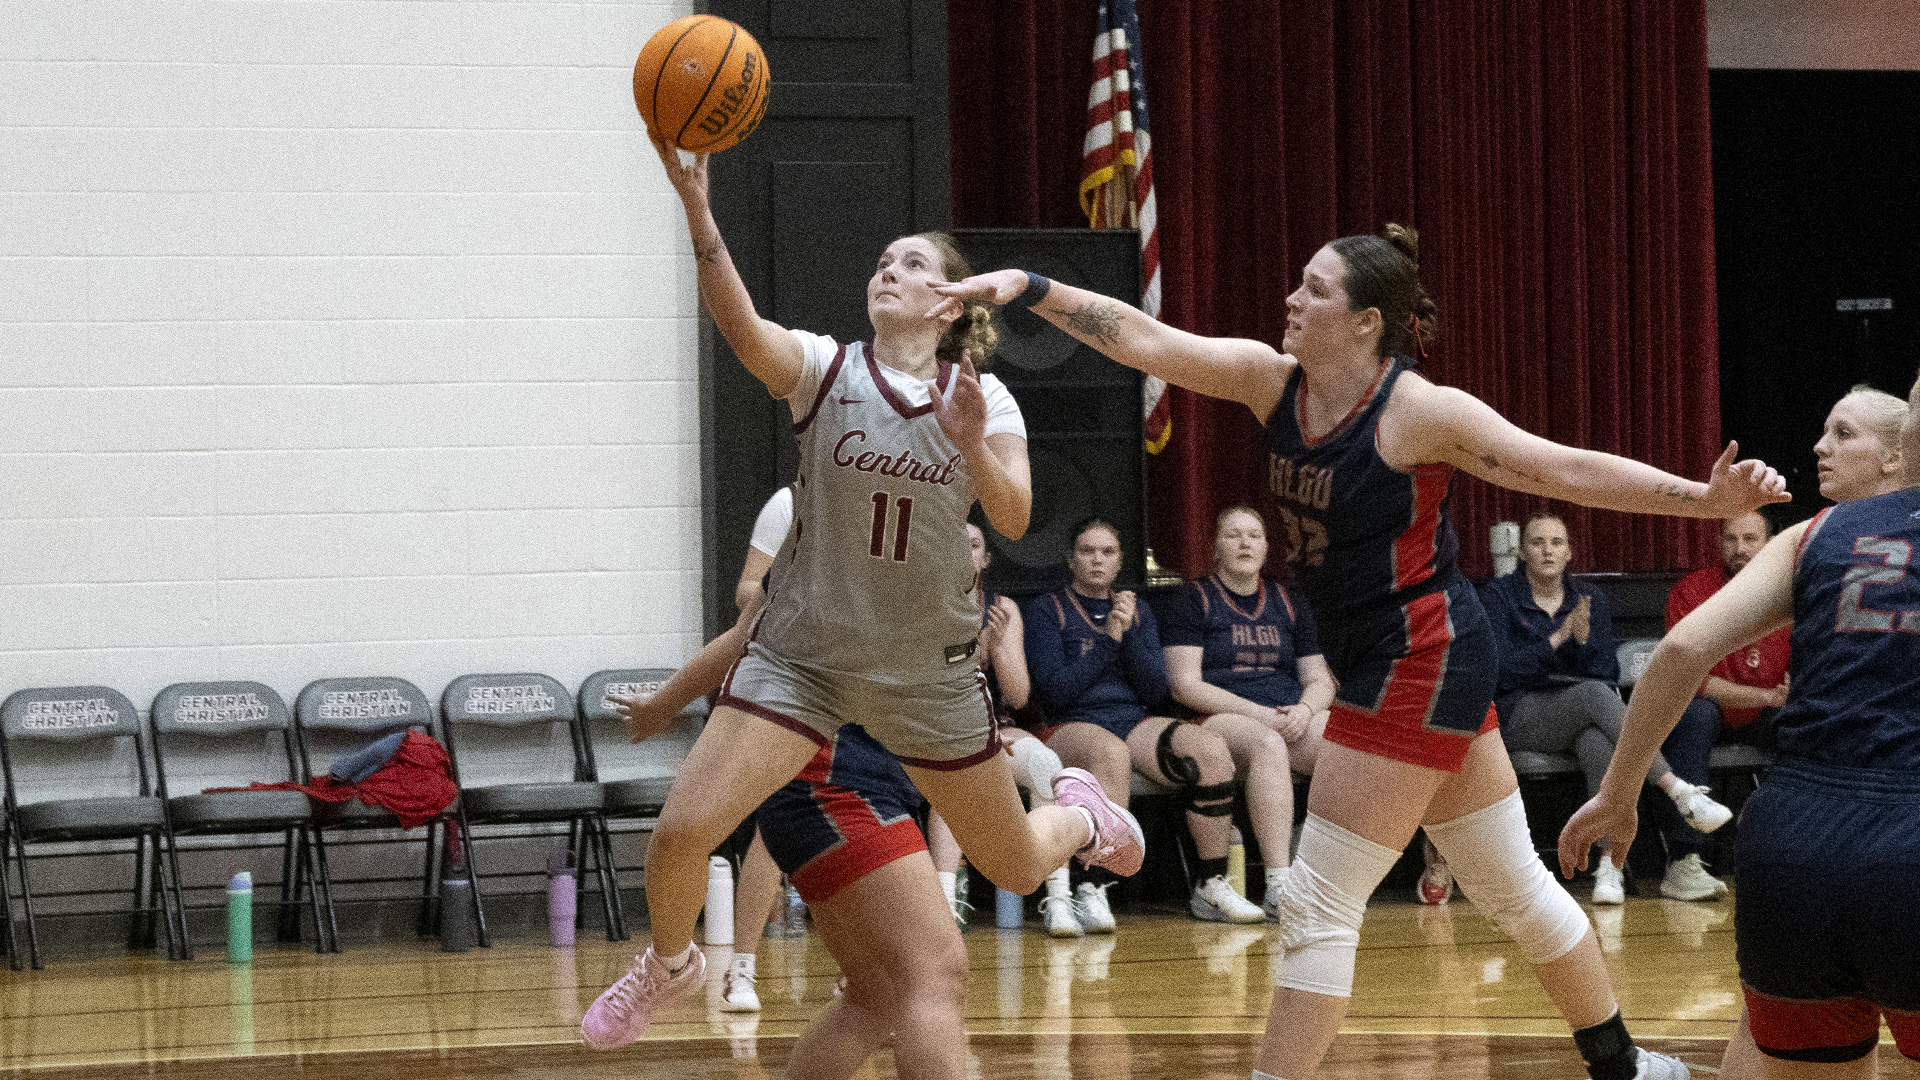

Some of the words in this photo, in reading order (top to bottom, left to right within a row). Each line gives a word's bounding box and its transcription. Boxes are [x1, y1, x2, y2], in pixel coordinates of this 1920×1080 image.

[698, 52, 757, 136] Wilson
[832, 429, 962, 486] Central
[869, 490, 914, 562] 11
[1834, 535, 1920, 635] 2
[180, 693, 262, 709] CENTRAL
[324, 688, 403, 705] CENTRAL
[470, 685, 547, 700] CENTRAL
[28, 699, 111, 715] CENTRAL
[175, 706, 268, 723] CHRISTIAN
[319, 701, 411, 719] CHRISTIAN
[465, 698, 554, 715] CHRISTIAN
[22, 710, 119, 729] CHRISTIAN
